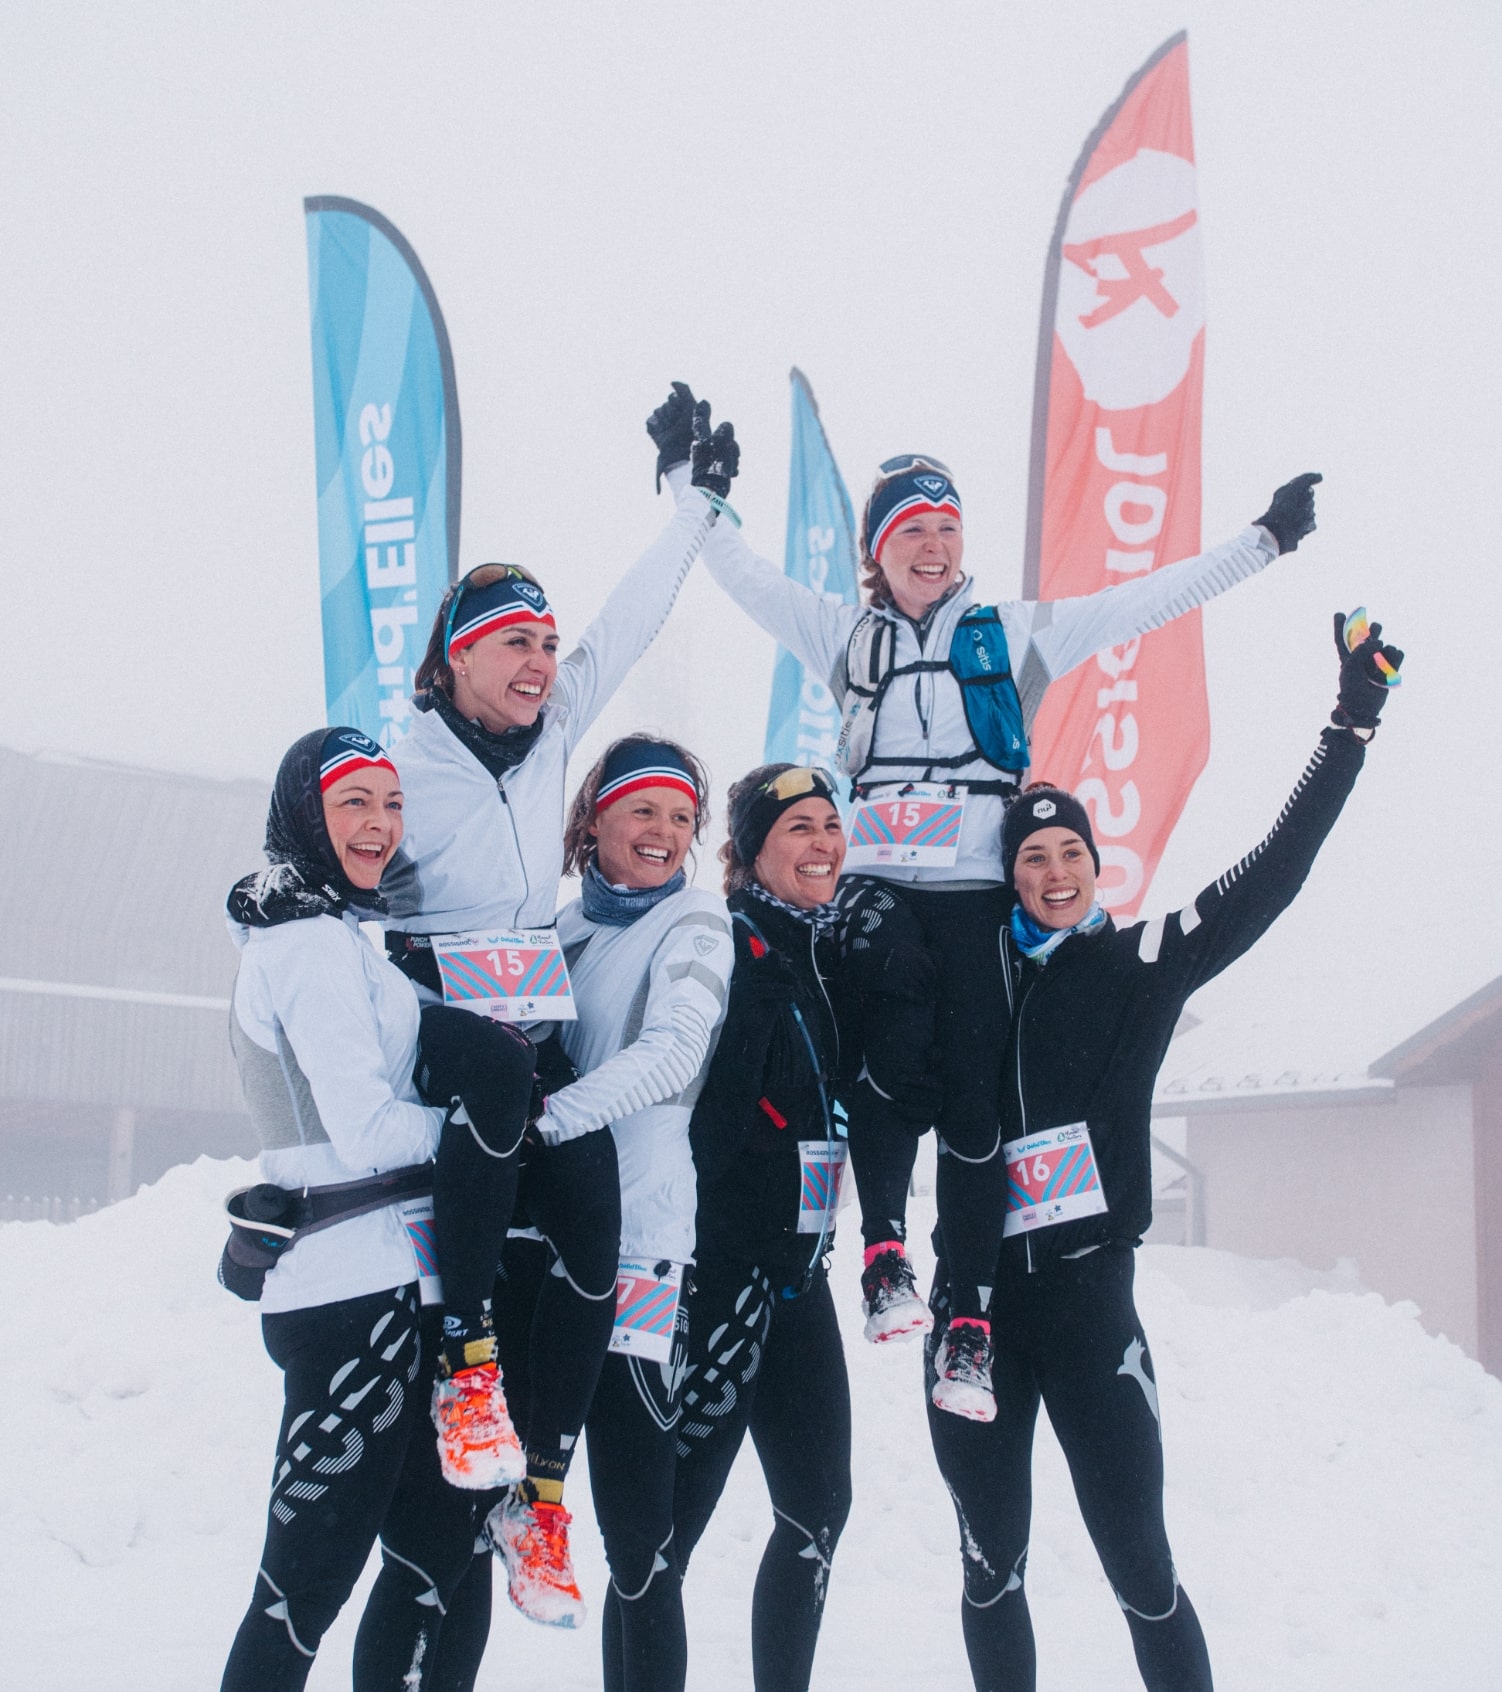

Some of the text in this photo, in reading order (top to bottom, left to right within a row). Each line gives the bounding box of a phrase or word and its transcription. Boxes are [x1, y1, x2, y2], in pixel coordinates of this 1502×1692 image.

[888, 803, 921, 827] 15
[486, 950, 525, 976] 15
[1016, 1155, 1050, 1186] 16
